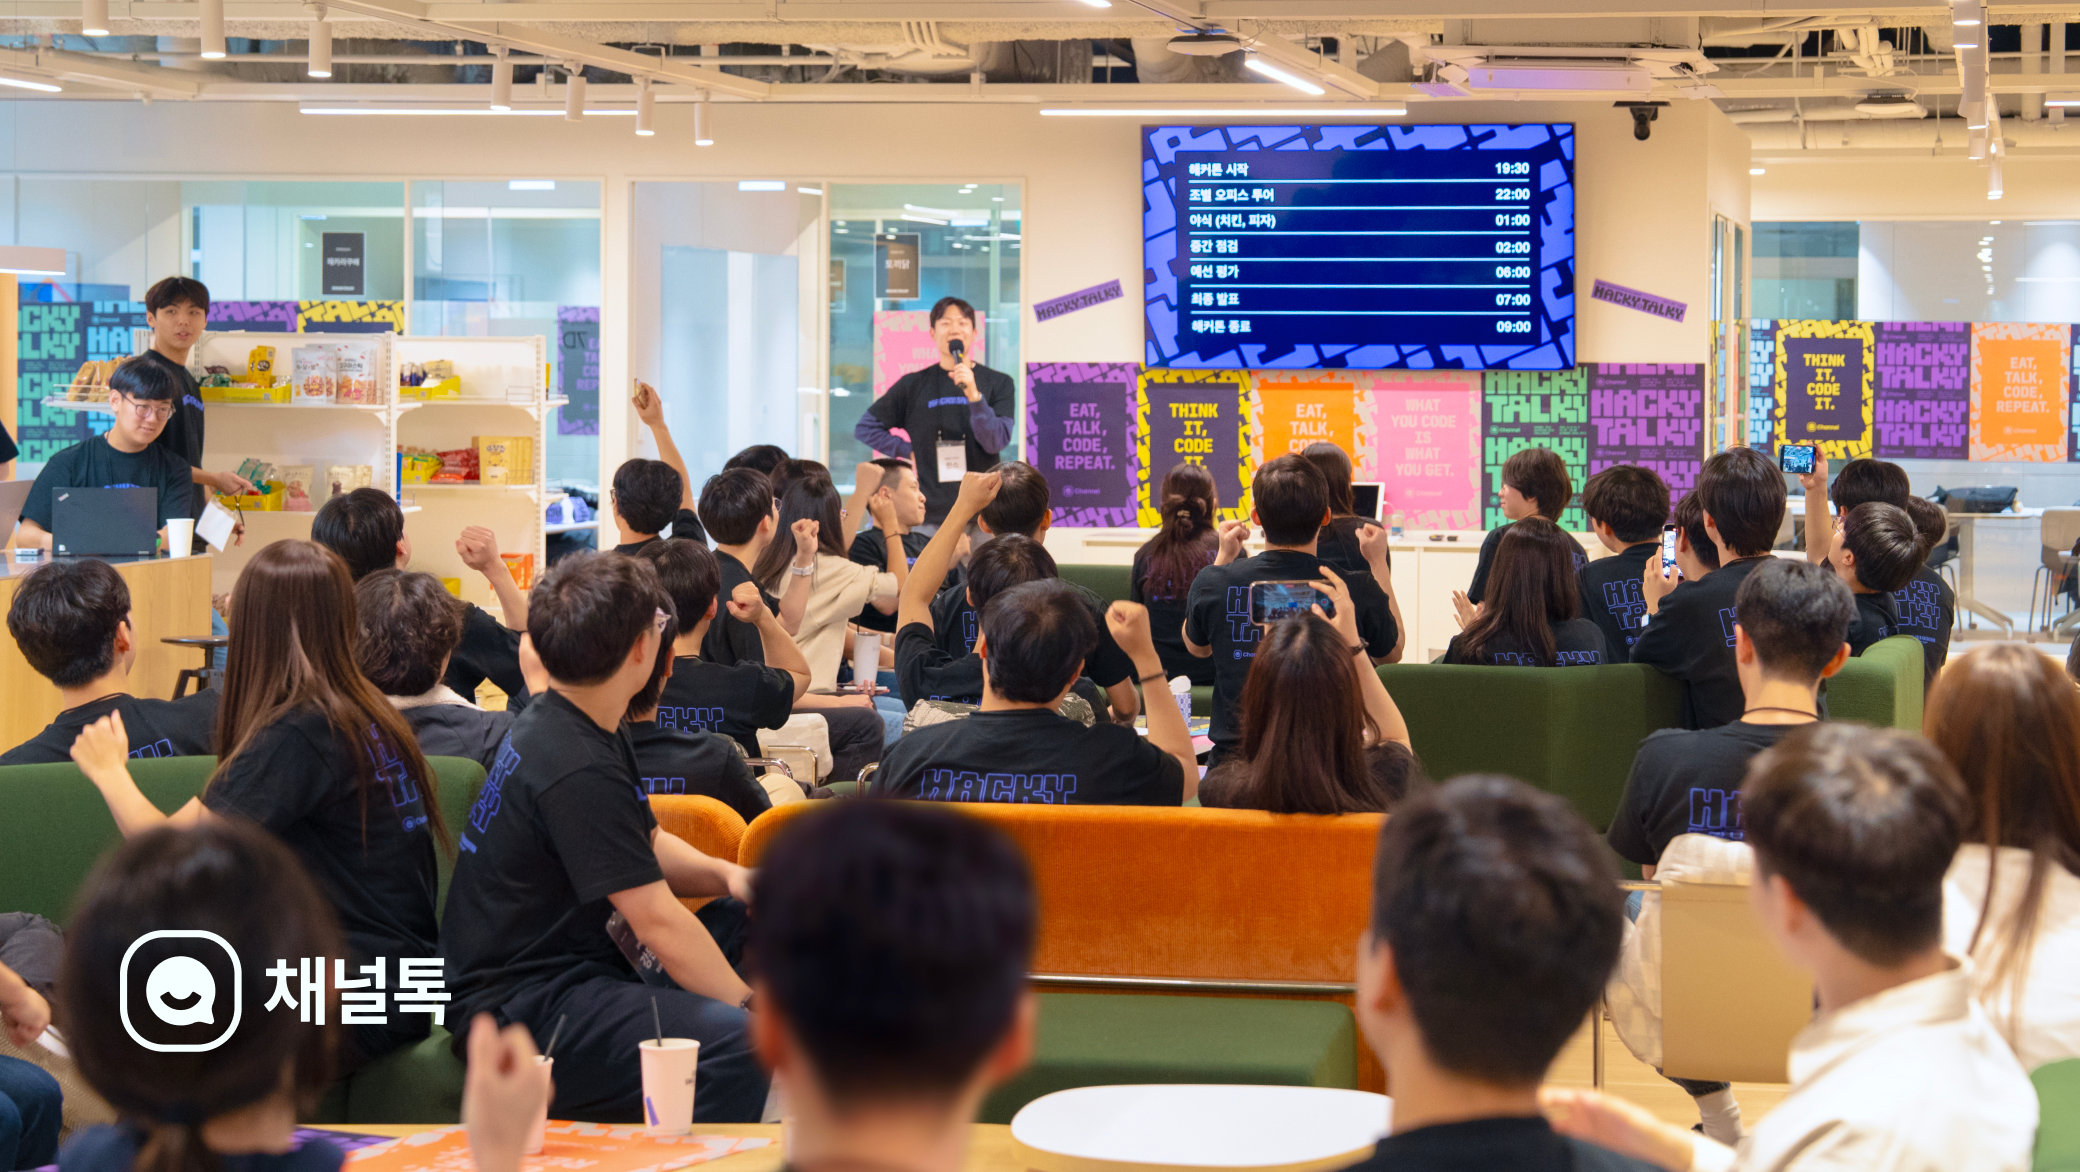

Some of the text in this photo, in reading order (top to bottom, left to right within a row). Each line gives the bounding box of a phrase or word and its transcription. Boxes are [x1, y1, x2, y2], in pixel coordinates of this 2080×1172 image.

[1188, 162, 1530, 177] 해커톤 시작 19:30
[1188, 187, 1531, 203] 조별 오피스 투어 22:00
[1189, 213, 1531, 229] 야식 (치킨, 피자) 01:00
[1190, 239, 1531, 254] 중간 점검 02:00
[1190, 264, 1531, 279] 예선 평가 06:00
[1036, 285, 1120, 320] HACKY TALKY
[1191, 292, 1531, 306] 최종 발표 07:00
[1594, 286, 1684, 320] HACKY TALKY
[18, 305, 81, 332] CKY
[1191, 319, 1532, 333] 해커톤 종료 09:00
[18, 333, 81, 359] LKY
[1803, 354, 1845, 367] THINK
[1877, 342, 1968, 366] HACKY
[2010, 357, 2038, 371] EAT,
[1485, 367, 1588, 394] HACKY
[1815, 368, 1836, 382] IT,
[1876, 366, 1967, 390] TALKY
[2004, 371, 2043, 385] TALK,
[1806, 383, 1841, 396] CODE
[2003, 386, 2043, 399] CODE,
[1169, 403, 1218, 418] THINK
[1405, 399, 1441, 411] WHAT
[1485, 395, 1588, 423] TALKY
[1591, 389, 1701, 417] HACKY
[1814, 397, 1836, 410] IT.
[1996, 400, 2050, 413] REPEAT.
[1070, 403, 1100, 419] EAT,
[1296, 403, 1327, 419] EAT,
[1876, 400, 1967, 423] HACKY
[1063, 421, 1107, 436] TALK,
[1183, 421, 1207, 437] IT,
[1289, 421, 1334, 437] TALK,
[1391, 415, 1456, 428] YOU CODE
[1415, 431, 1432, 444] IS
[1591, 418, 1701, 446] TALKY
[1876, 423, 1967, 447] TALKY
[1063, 438, 1107, 454] CODE,
[1174, 438, 1213, 453] CODE
[1405, 447, 1441, 460] WHAT
[1055, 455, 1115, 470] REPEAT.
[1396, 464, 1454, 477] YOU GET.
[918, 768, 1077, 804] HACKY
